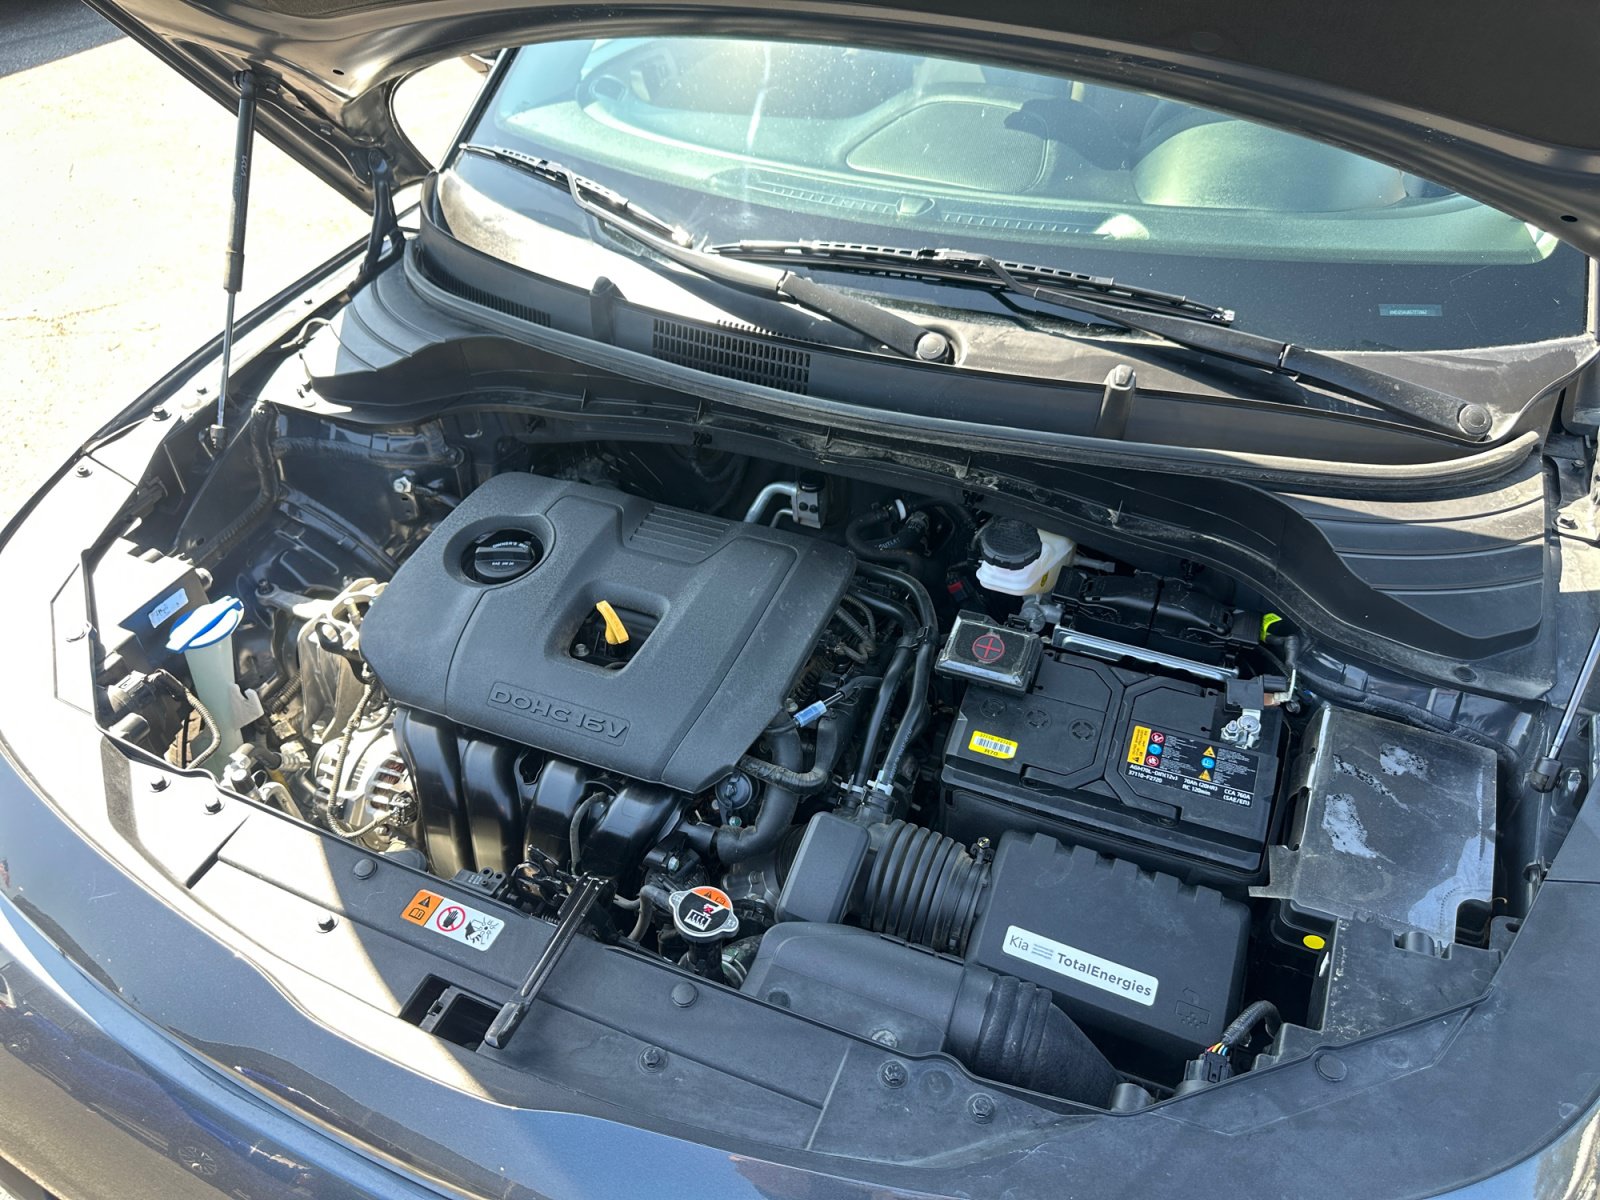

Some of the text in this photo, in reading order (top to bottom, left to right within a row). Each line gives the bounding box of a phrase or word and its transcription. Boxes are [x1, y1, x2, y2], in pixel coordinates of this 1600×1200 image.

[490, 691, 628, 739] DOHC 16V
[1128, 770, 1163, 783] 37110-F2720
[1184, 778, 1218, 792] 70Ah (20HR)
[1191, 786, 1211, 796] 120min
[1223, 788, 1251, 800] CCA 760A
[1009, 934, 1152, 997] Kia TotalEnergies
